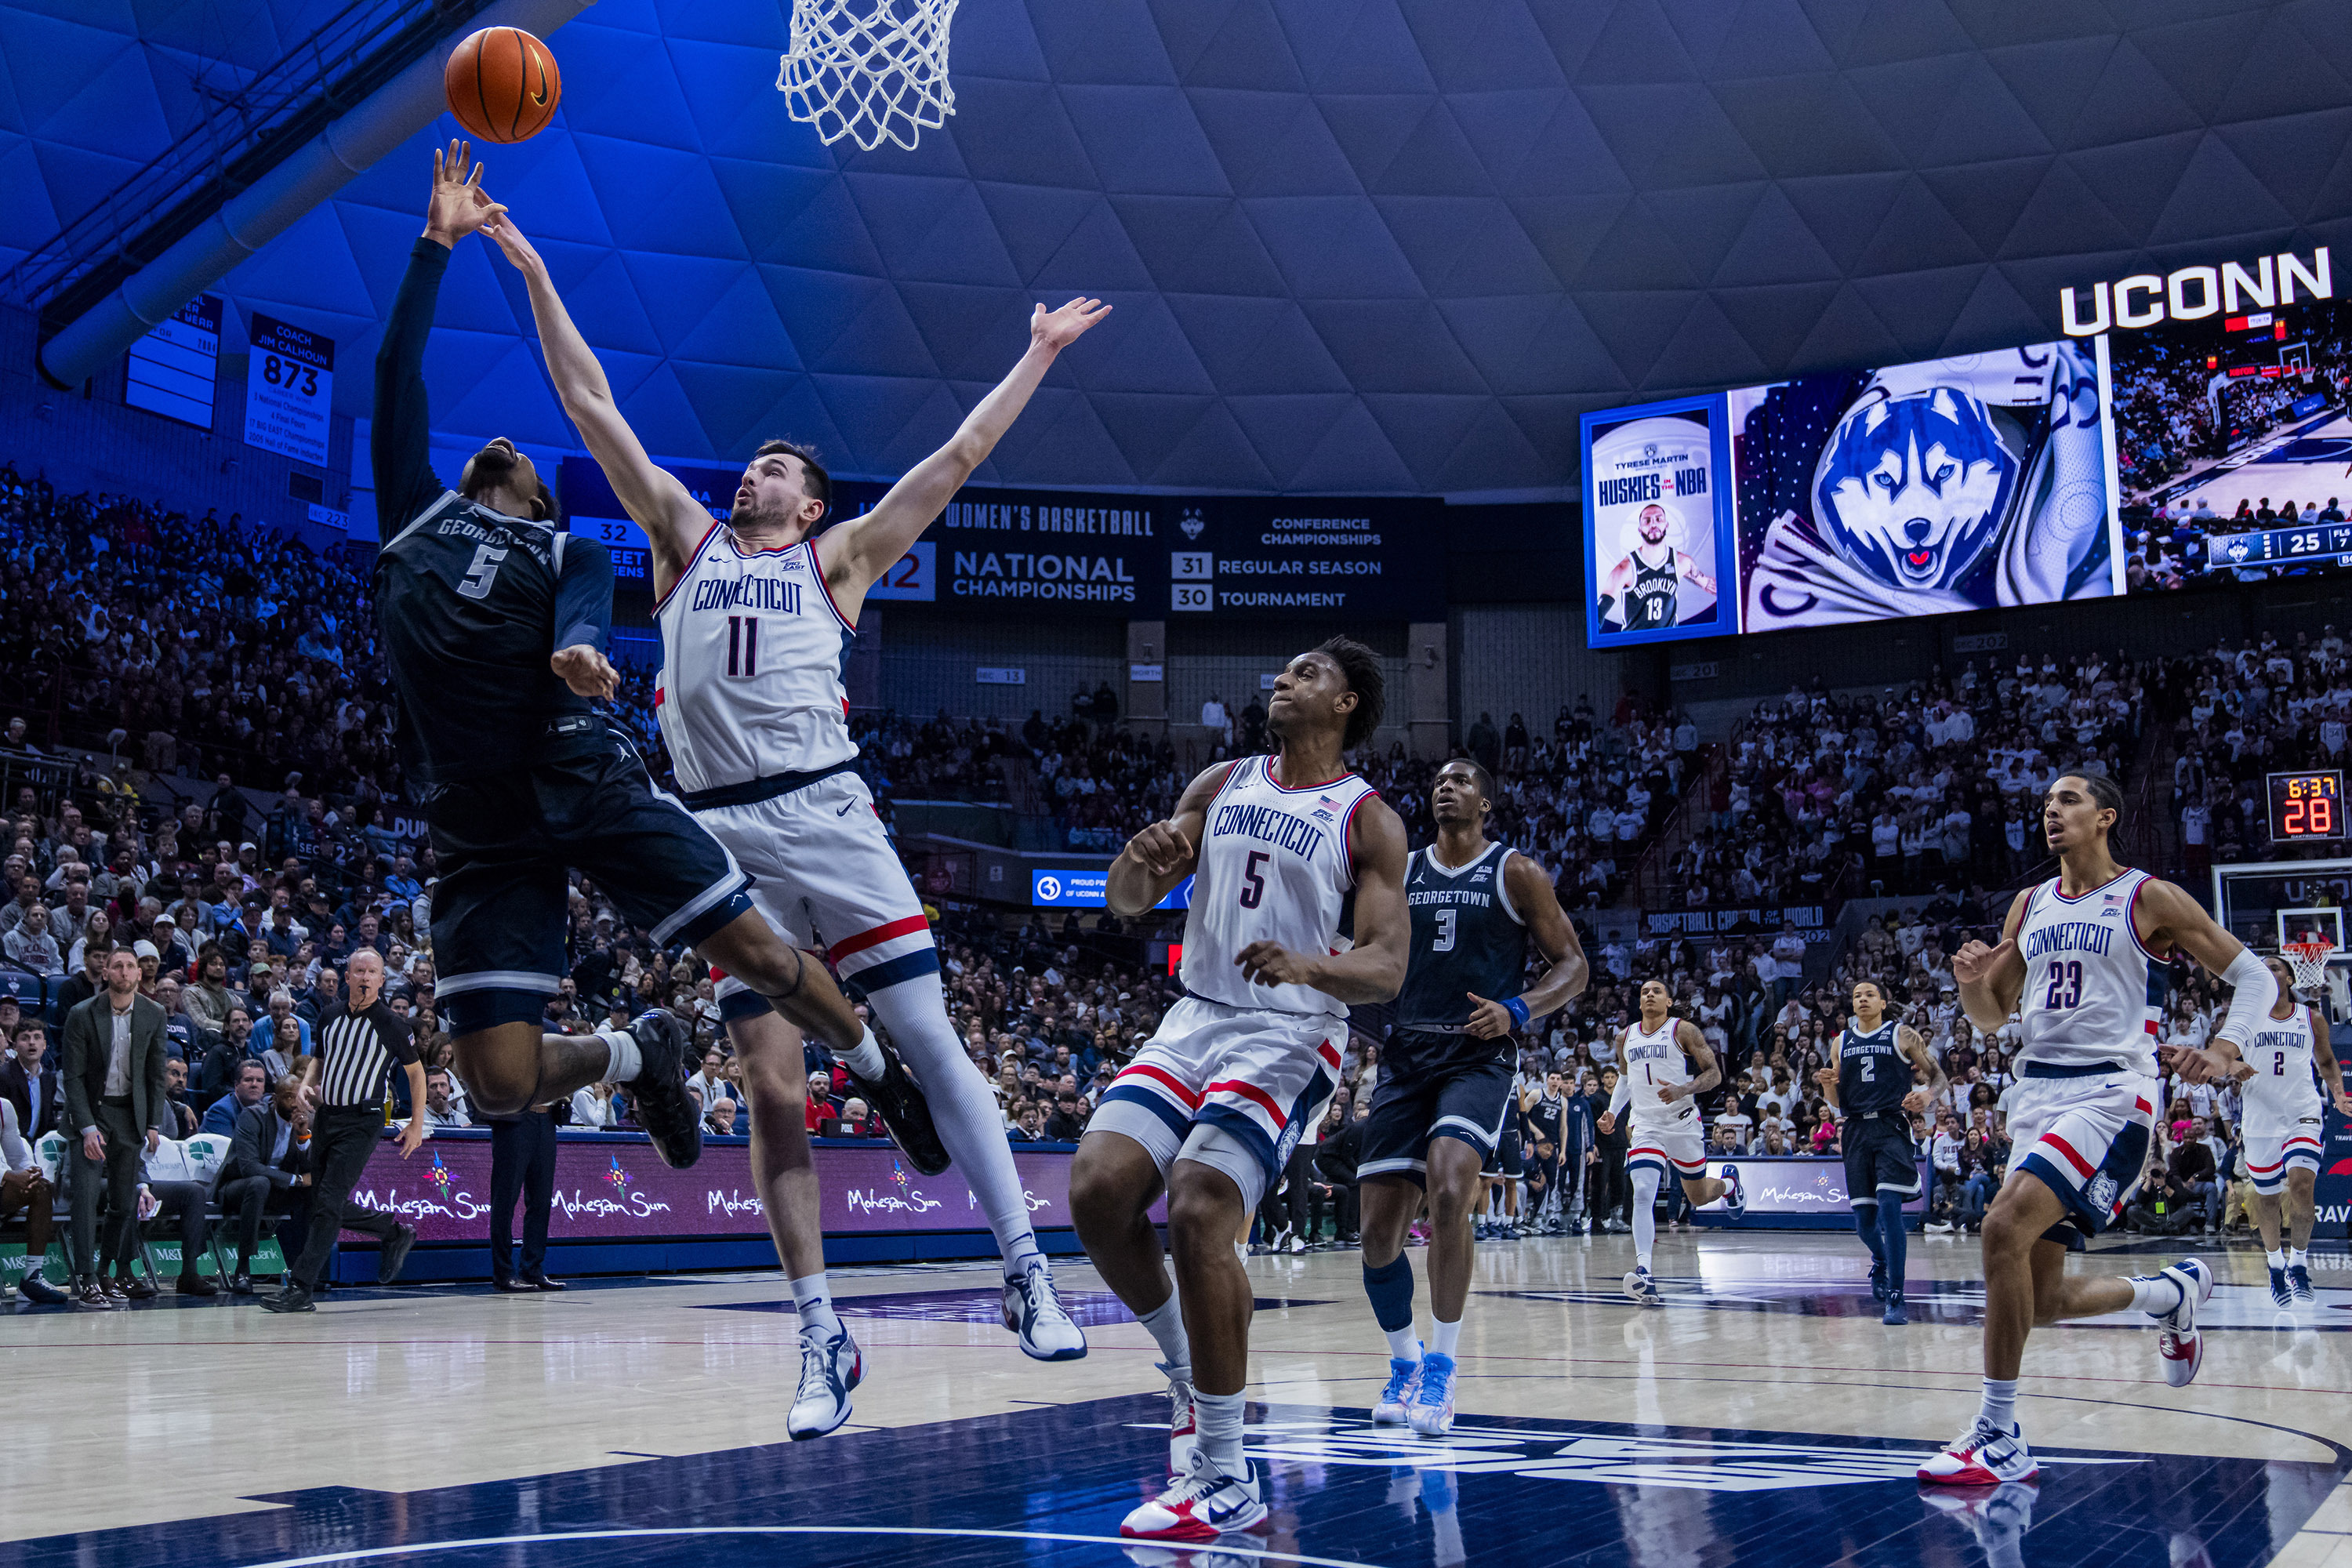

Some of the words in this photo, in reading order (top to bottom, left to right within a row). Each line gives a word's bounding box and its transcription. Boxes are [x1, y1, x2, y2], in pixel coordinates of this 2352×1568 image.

[2060, 246, 2333, 337] UCONN
[184, 312, 213, 331] YEAR
[276, 325, 312, 346] COACH
[258, 335, 276, 349] JIM
[278, 342, 327, 366] CALHOUN
[263, 355, 318, 397] 873
[259, 394, 282, 409] National
[282, 401, 324, 423] Championships
[276, 413, 290, 425] Final
[291, 418, 307, 430] Fours
[249, 419, 255, 427] 17
[256, 420, 267, 431] BIG
[268, 424, 283, 436] EAST
[284, 430, 325, 450] Championships
[249, 432, 263, 445] 2005
[265, 436, 276, 447] Hall
[277, 440, 283, 450] of
[284, 442, 299, 456] Fame
[1615, 459, 1650, 470] TYRESE
[1652, 454, 1689, 465] MARTIN
[1599, 473, 1661, 507] HUSKIES
[1675, 467, 1707, 497] NBA
[325, 511, 349, 528] 223
[945, 502, 1032, 532] WOMEN'S
[1038, 506, 1154, 537] BASKETBALL
[1272, 517, 1370, 531] CONFERENCE
[601, 524, 626, 542] 32
[1261, 532, 1382, 546] CHAMPIONSHIPS
[2290, 532, 2320, 554] 25
[2333, 528, 2350, 538] FLS
[2339, 539, 2347, 548] 7
[456, 544, 509, 599] 5
[953, 551, 1135, 583] NATIONAL
[1182, 557, 1204, 574] 31
[1218, 559, 1305, 575] REGULAR
[1308, 561, 1382, 575] SEASON
[953, 579, 1137, 603] CHAMPIONSHIPS
[1178, 588, 1207, 606] 30
[1220, 592, 1346, 607] TOURNAMENT
[1633, 577, 1677, 600] BROOKLYN
[1646, 597, 1663, 621] 13
[728, 615, 757, 676] 11
[1976, 636, 2006, 649] 202
[1004, 670, 1019, 682] 13
[2288, 776, 2335, 798] 6:37
[1312, 812, 1335, 822] EAST
[1317, 808, 1334, 818] BIG
[2284, 797, 2331, 834] 28
[1214, 804, 1324, 862] CONNECTICUT
[299, 842, 320, 855] SEC
[1071, 878, 1094, 887] PROUD
[1240, 850, 1270, 909] 5
[1408, 890, 1490, 908] GEORGETOWN
[1433, 909, 1457, 951] 3
[1647, 911, 1715, 934] BASKETBALL
[1783, 906, 1824, 927] WORLD
[2027, 922, 2114, 961] CONNECTICUT
[2045, 960, 2082, 1009] 23
[2255, 1031, 2306, 1049] CONNECTICUT
[1628, 1044, 1668, 1064] CONNECTICUT
[1843, 1045, 1893, 1058] GEORGETOWN
[1645, 1063, 1653, 1085] 1
[1860, 1056, 1875, 1082] 2
[2274, 1051, 2285, 1076] 2
[1543, 1107, 1558, 1120] 22
[354, 1189, 452, 1220] Mohegan
[551, 1189, 630, 1221] Mohegan
[630, 1192, 670, 1217] Sun
[848, 1189, 913, 1215] Mohegan
[911, 1191, 942, 1213] Sun
[1025, 1190, 1051, 1211] Sun
[1759, 1186, 1824, 1203] Mohegan
[1827, 1189, 1850, 1203] Su
